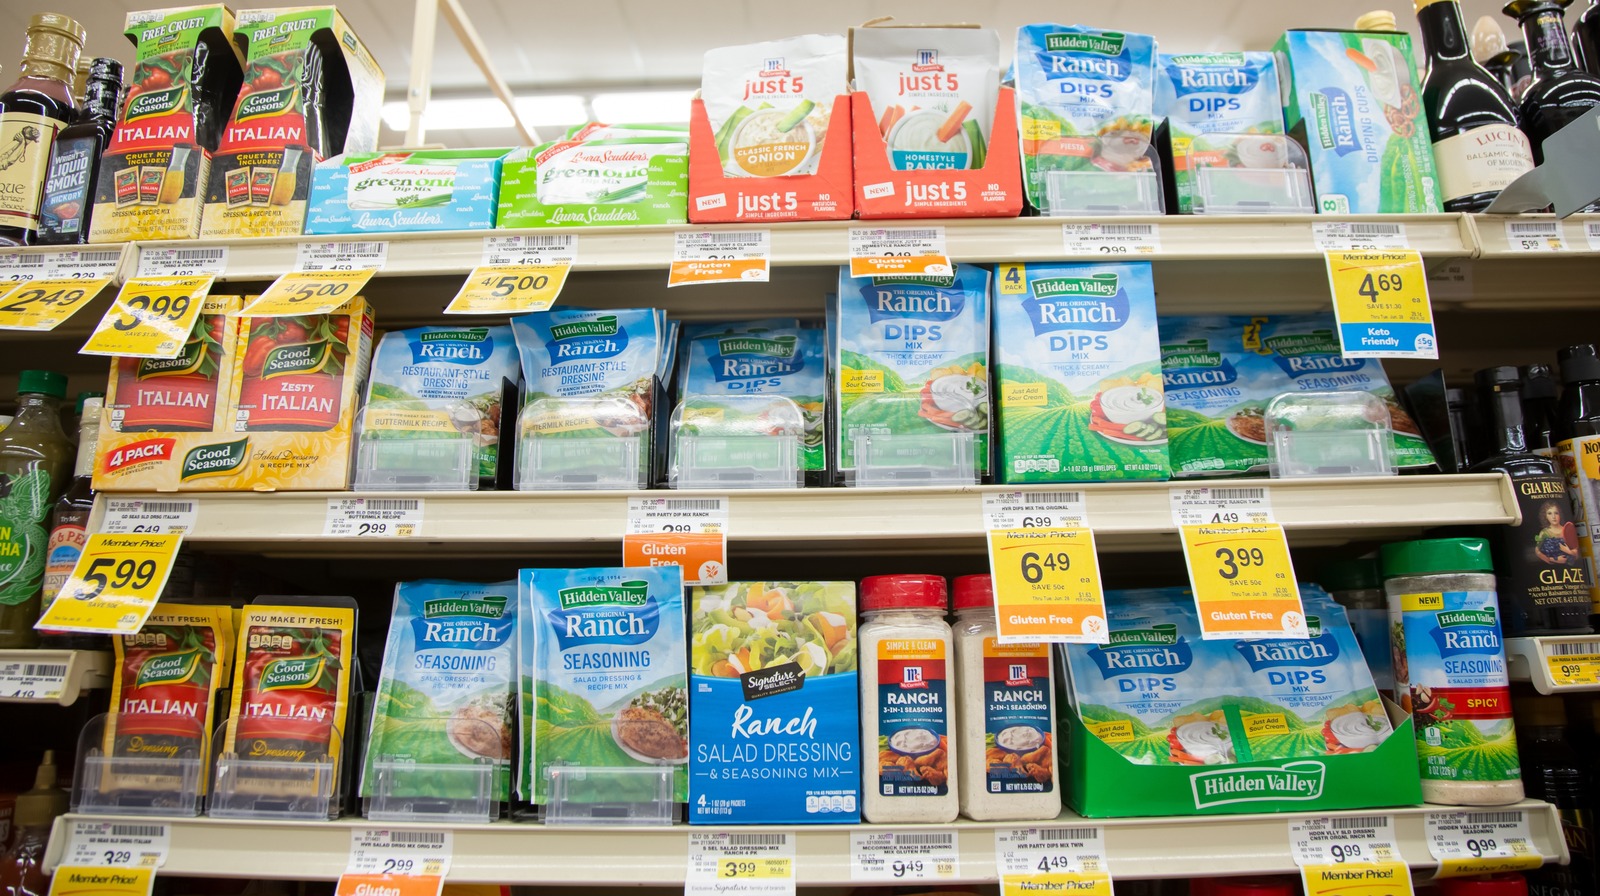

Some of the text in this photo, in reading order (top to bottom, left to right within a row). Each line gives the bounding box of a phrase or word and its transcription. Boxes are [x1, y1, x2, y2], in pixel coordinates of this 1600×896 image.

[1052, 56, 1119, 77] Ranch
[899, 72, 958, 96] just 5
[1181, 68, 1247, 87] Ranch
[743, 77, 803, 101] just 5
[139, 93, 169, 105] Good
[250, 93, 280, 105] Good
[1332, 96, 1354, 147] Ranch
[1355, 85, 1379, 163] DIPPING CUPS
[118, 127, 190, 143] ITALIAN
[229, 128, 301, 143] ITALIAN
[126, 153, 153, 161] CRUET
[237, 153, 265, 161] CRUET
[570, 151, 647, 163] Laura Scudder's
[738, 146, 771, 156] CLASSIC
[905, 154, 955, 162] HOMESTYLE
[905, 181, 966, 206] just 5
[737, 192, 797, 218] just 5
[546, 207, 637, 224] Laura Scudder's
[1036, 281, 1113, 294] Hidden Valley
[1039, 302, 1117, 324] Ranch
[458, 332, 483, 341] Valley
[885, 325, 942, 341] DIPS
[1368, 328, 1390, 336] Keto
[723, 341, 791, 354] Hidden Valley
[1362, 337, 1399, 347] Friendly
[420, 344, 481, 359] Ranch
[145, 357, 191, 370] Seasons
[281, 382, 315, 392] ZESTY
[728, 378, 781, 389] DIPS
[137, 390, 209, 408] ITALIAN
[261, 394, 333, 413] ITALIAN
[188, 456, 237, 471] Seasons
[140, 540, 165, 548] Price!
[642, 544, 686, 555] Gluten
[649, 558, 679, 566] Free
[1539, 568, 1585, 585] GLAZE
[564, 591, 642, 605] Hidden Valley
[1418, 596, 1440, 605] NEW!
[250, 615, 268, 623] YOU
[270, 616, 296, 624] MAKE
[310, 617, 343, 625] FRESH!
[1444, 631, 1499, 649] Ranch
[151, 658, 182, 670] Good
[563, 650, 650, 670] SEASONING
[143, 667, 186, 679] Seasons
[274, 662, 305, 674] Good
[1445, 660, 1503, 674] SEASONING
[888, 693, 938, 705] RANCH
[994, 690, 1043, 702] RANCH
[1467, 698, 1498, 708] SPICY
[731, 704, 817, 739] Ranch
[697, 742, 852, 763] SALAD DRESSING
[710, 767, 839, 780] & SEASONING MIX
[1204, 774, 1316, 795] Hidden Valley
[69, 874, 138, 884] Member Price!
[1322, 869, 1393, 880] Member Price!
[356, 884, 400, 896] Gluten
[1021, 881, 1095, 890] Member Price!
